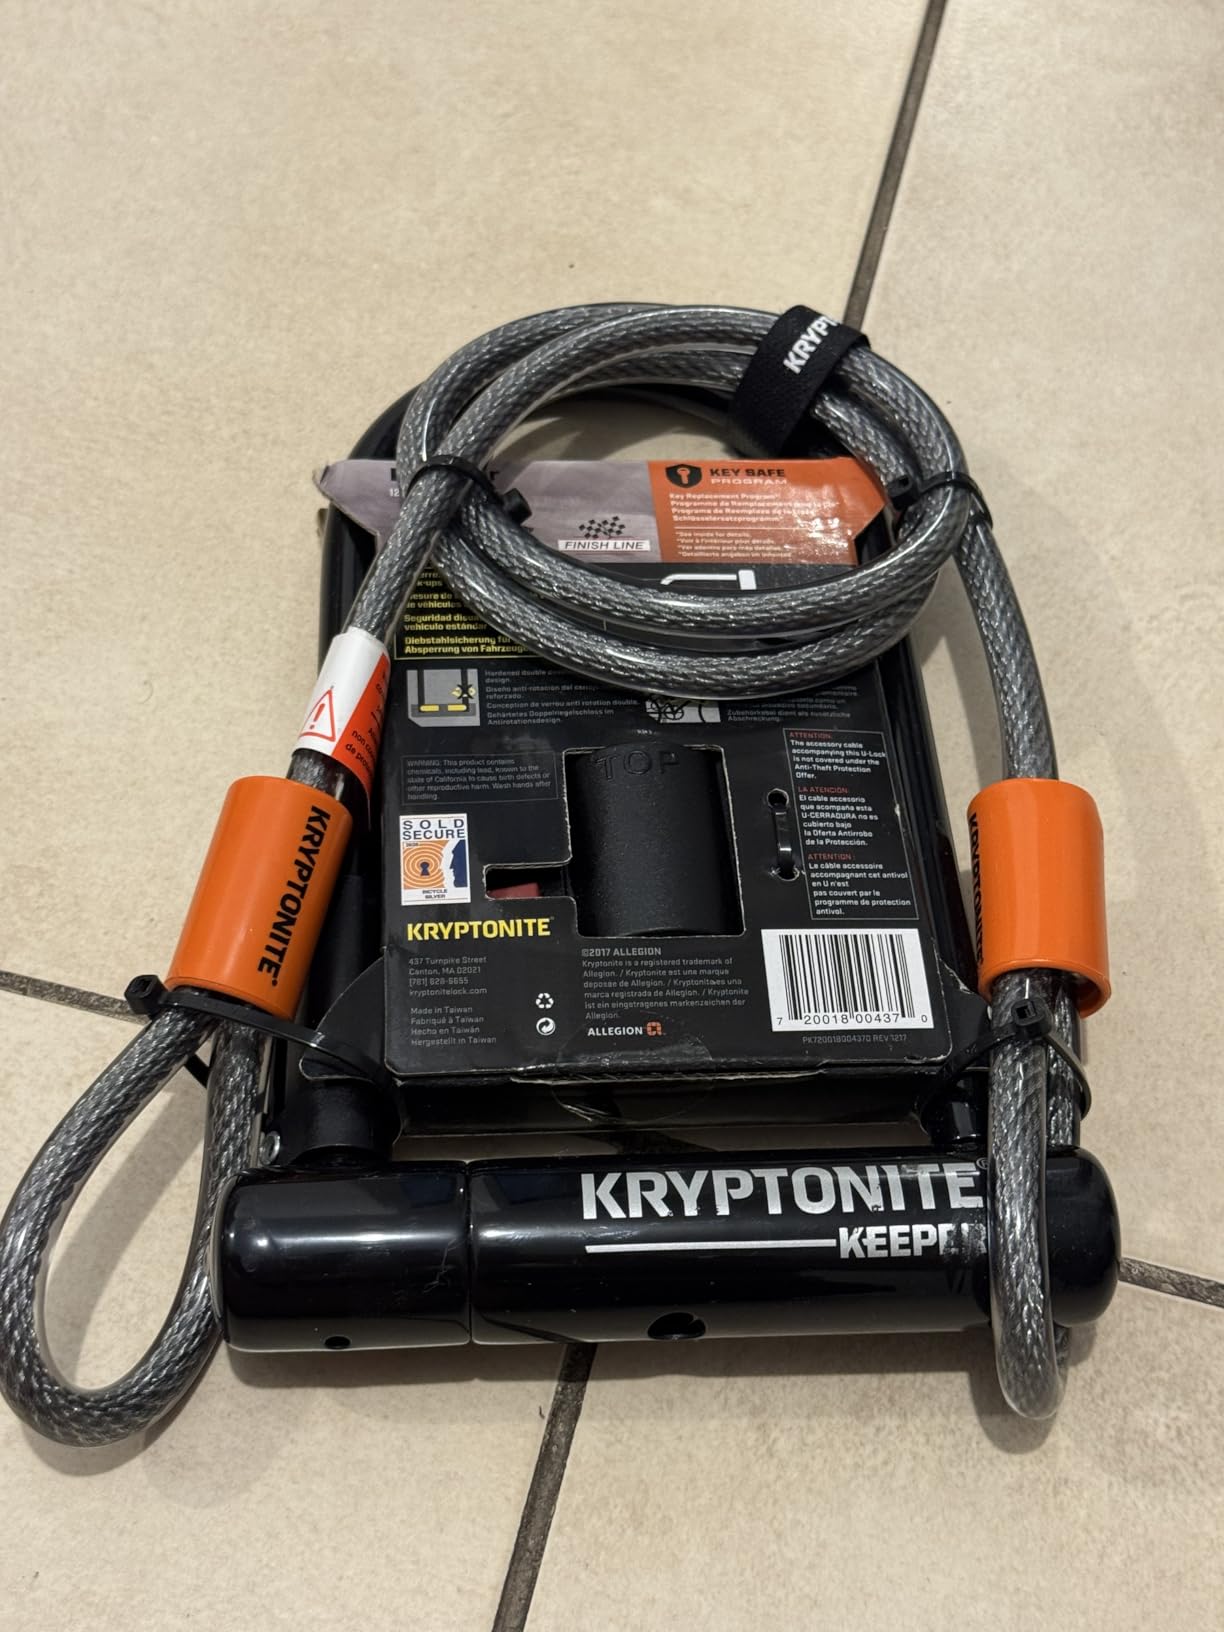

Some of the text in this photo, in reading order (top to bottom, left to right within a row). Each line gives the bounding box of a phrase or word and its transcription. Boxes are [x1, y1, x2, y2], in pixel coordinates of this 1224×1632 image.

[710, 468, 785, 477] KEY SAFE
[564, 541, 645, 550] FINISH LINE
[404, 645, 478, 655] Absperrung von
[351, 730, 366, 745] non
[345, 742, 357, 754] de
[805, 741, 842, 749] accessory
[791, 748, 887, 758] accompanying this U-Lock
[595, 750, 681, 782] TOP
[815, 756, 845, 764] covered
[845, 757, 866, 765] under
[867, 758, 880, 766] the
[794, 763, 871, 773] Anti-Theft Protection
[795, 771, 817, 779] Offer.
[807, 794, 829, 802] cable
[829, 795, 866, 803] accesorio
[800, 803, 814, 811] que
[856, 804, 873, 812] esta
[801, 811, 879, 821] U-CERRADURA no es
[402, 819, 465, 831] SOLD
[835, 821, 852, 829] bajo
[402, 829, 465, 841] SECURE
[804, 829, 873, 838] la Oferta Antirrobo
[816, 838, 824, 846] la
[808, 862, 819, 870] Le
[842, 862, 883, 870] accessoire
[810, 871, 908, 880] accompagnant cet antivol
[823, 880, 829, 888] U
[830, 880, 849, 888] n'est
[813, 889, 880, 898] pas couvert par le
[814, 899, 859, 907] programme
[871, 898, 911, 907] protection
[815, 907, 846, 915] antivol.
[407, 918, 551, 941] KRYPTONITE
[613, 947, 662, 957] ALLEGION
[408, 955, 488, 966] 437 Turnpike Street
[582, 959, 623, 969] Kryptonite
[625, 959, 633, 967] is
[640, 958, 681, 968] registered
[682, 957, 722, 966] trademark
[724, 957, 733, 965] of
[456, 966, 481, 974] 02021
[625, 968, 666, 978] Kryptonite
[667, 968, 681, 976] est
[682, 968, 697, 976] une
[699, 968, 730, 977] marque
[619, 979, 629, 988] de
[727, 978, 742, 986] una
[584, 991, 610, 999] marca
[611, 990, 651, 1000] registrada
[653, 989, 664, 998] de
[707, 987, 749, 997] Kryptonite
[584, 998, 746, 1010] ist ein eingetragenes markenzeichen der
[410, 1005, 473, 1015] Made in Taiwan
[777, 1013, 928, 1025] 7 20018 00437 0
[411, 1027, 437, 1035] Hecho
[587, 1026, 643, 1036] ALLEGION
[411, 1036, 497, 1047] Hergestellt in Taiwan
[873, 1034, 889, 1043] REV
